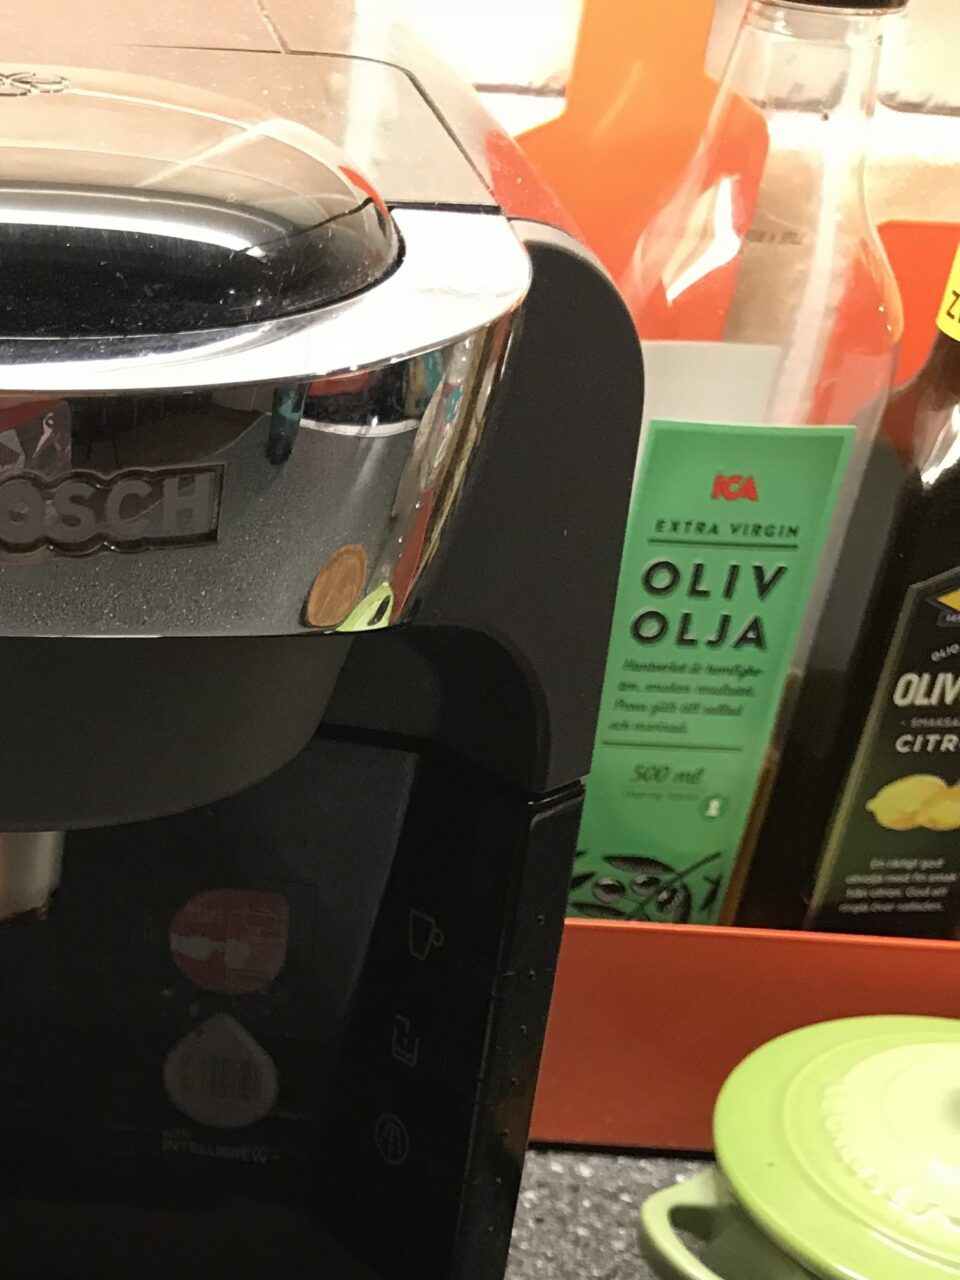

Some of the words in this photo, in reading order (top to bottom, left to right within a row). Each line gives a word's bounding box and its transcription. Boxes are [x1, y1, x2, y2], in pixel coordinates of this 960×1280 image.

[711, 473, 759, 502] ICA
[654, 519, 719, 535] EXTRA
[730, 522, 800, 538] VIRGIN
[642, 560, 788, 600] OLIV
[631, 608, 767, 650] OLJA
[630, 763, 670, 783] 500
[672, 766, 704, 785] ml
